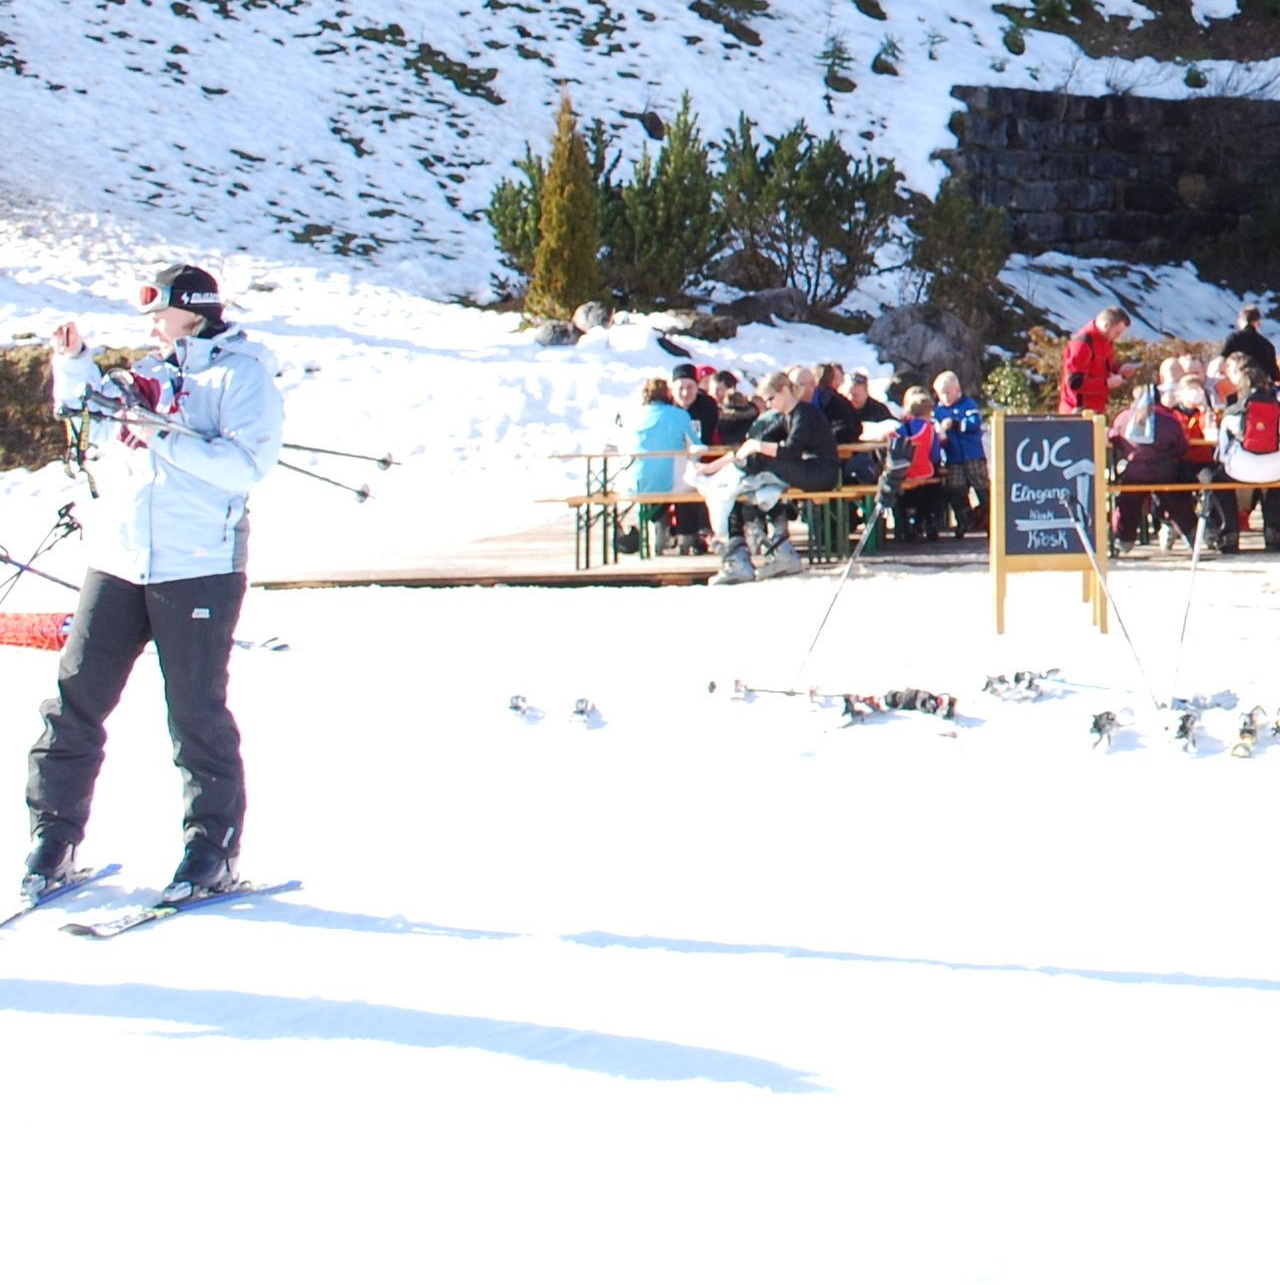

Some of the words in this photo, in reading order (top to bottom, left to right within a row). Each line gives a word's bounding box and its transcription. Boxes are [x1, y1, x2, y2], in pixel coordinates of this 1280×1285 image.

[1016, 436, 1073, 472] WC
[1010, 482, 1070, 505] Eingang
[1027, 530, 1068, 550] Kiosk
